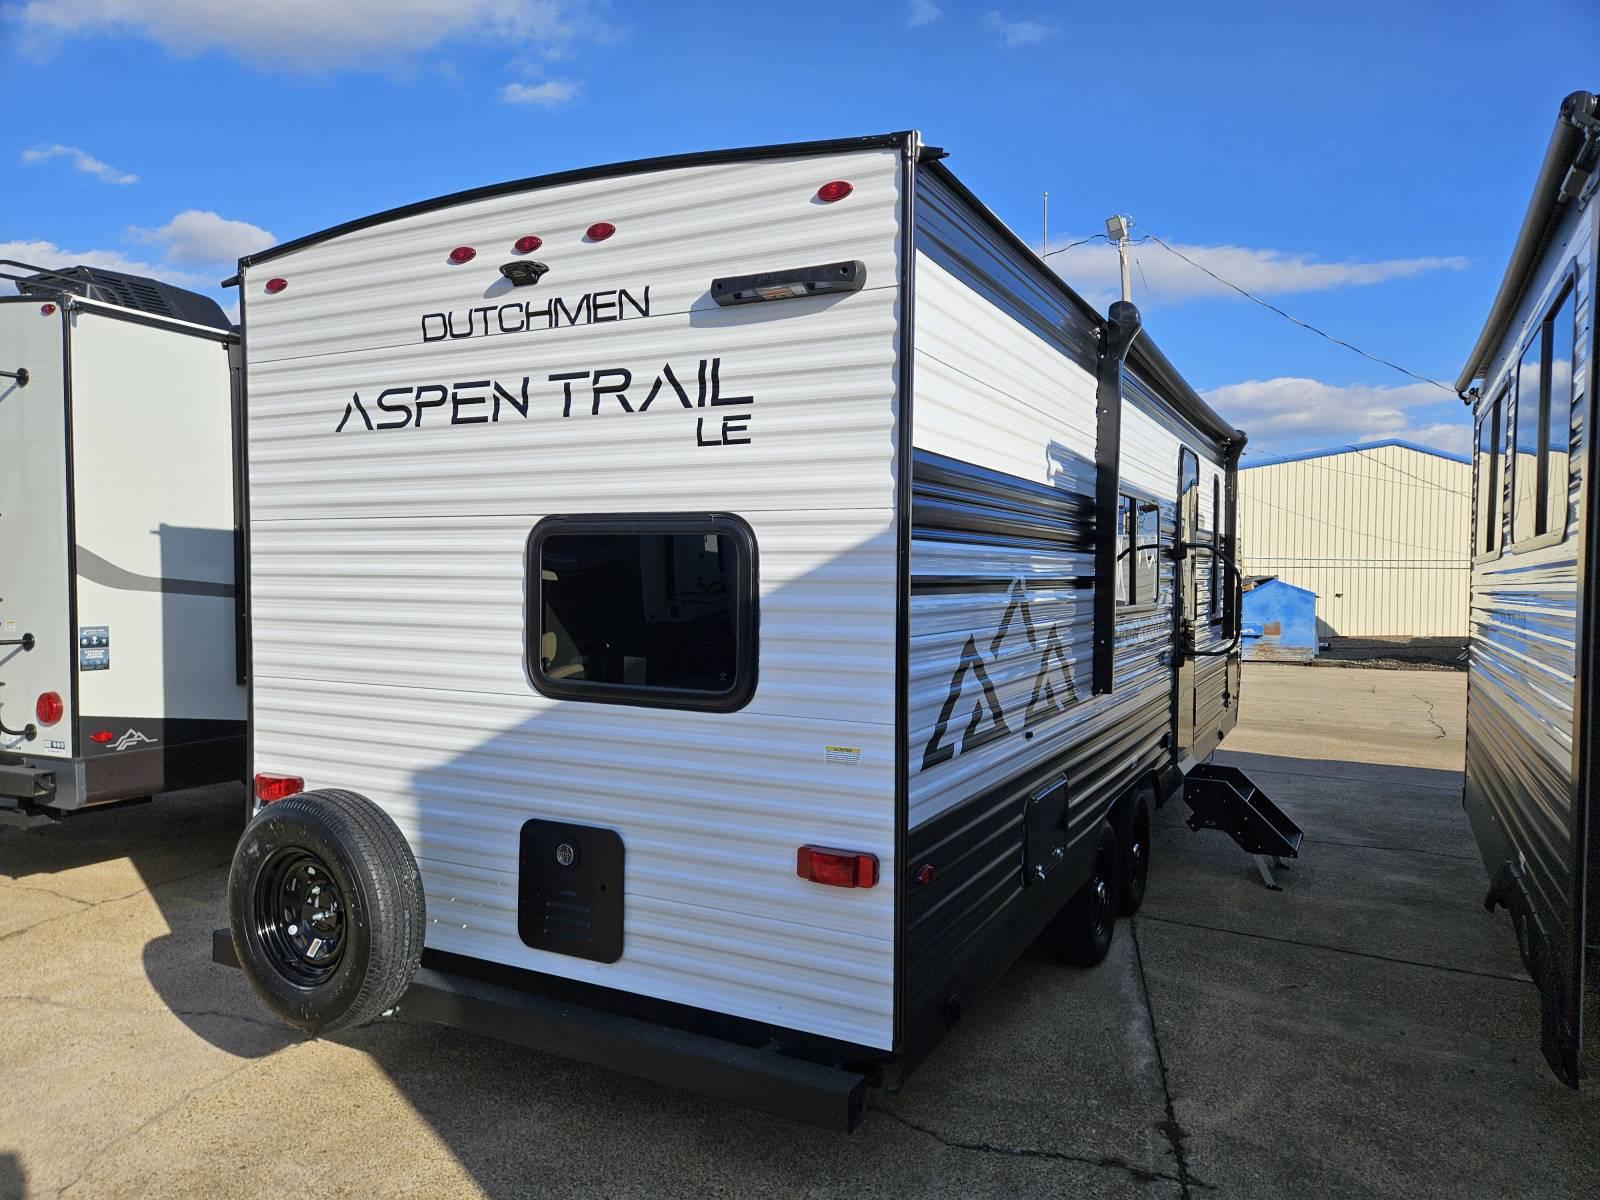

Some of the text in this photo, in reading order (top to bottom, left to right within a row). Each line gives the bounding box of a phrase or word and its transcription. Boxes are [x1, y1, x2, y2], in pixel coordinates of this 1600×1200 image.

[422, 285, 650, 343] DUTCHMEN
[336, 357, 755, 433] ASPEN TRAIL
[696, 414, 752, 448] LE
